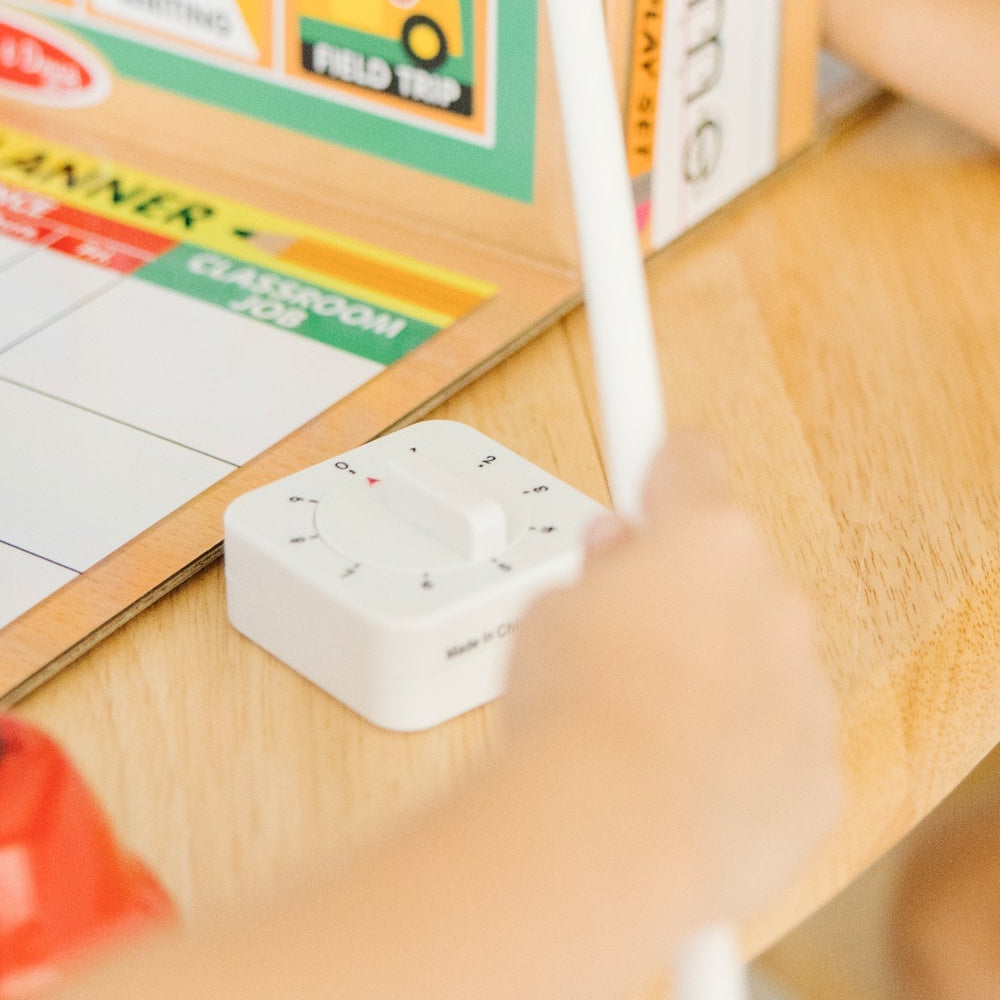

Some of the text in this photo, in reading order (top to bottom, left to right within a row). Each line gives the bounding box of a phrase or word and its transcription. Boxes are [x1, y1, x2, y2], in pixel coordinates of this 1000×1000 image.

[312, 42, 462, 110] FIELD TRIP
[187, 252, 406, 339] CLASSROOM
[230, 295, 308, 329] JOB
[334, 461, 349, 470] 0
[482, 455, 496, 465] 2
[533, 485, 548, 493] 3
[445, 638, 479, 660] Made
